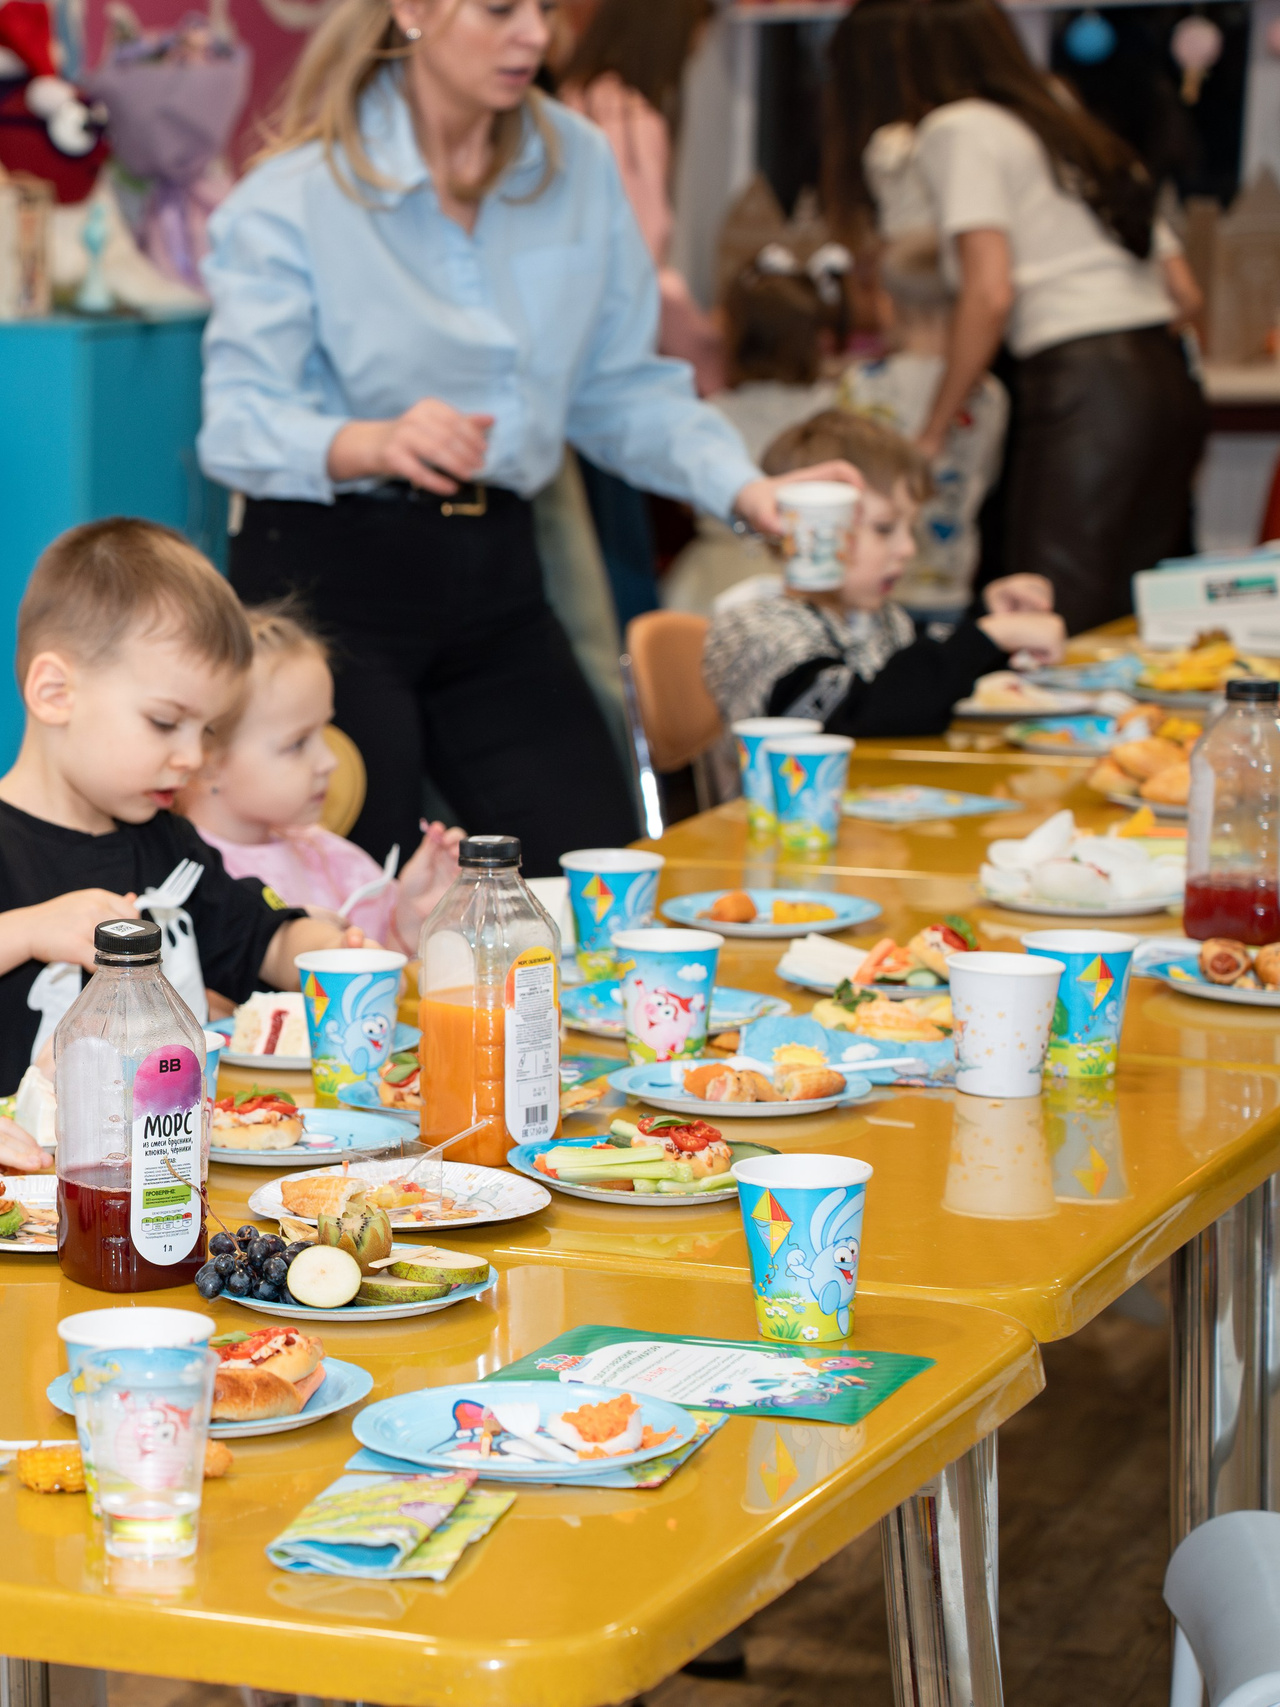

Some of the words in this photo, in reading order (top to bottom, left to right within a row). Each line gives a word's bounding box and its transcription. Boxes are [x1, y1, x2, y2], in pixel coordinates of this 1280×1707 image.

[143, 1111, 193, 1139] МОРС
[150, 1139, 167, 1148] смеси
[167, 1136, 194, 1148] брусники,
[144, 1148, 170, 1157] клюквы,
[170, 1145, 192, 1155] черники
